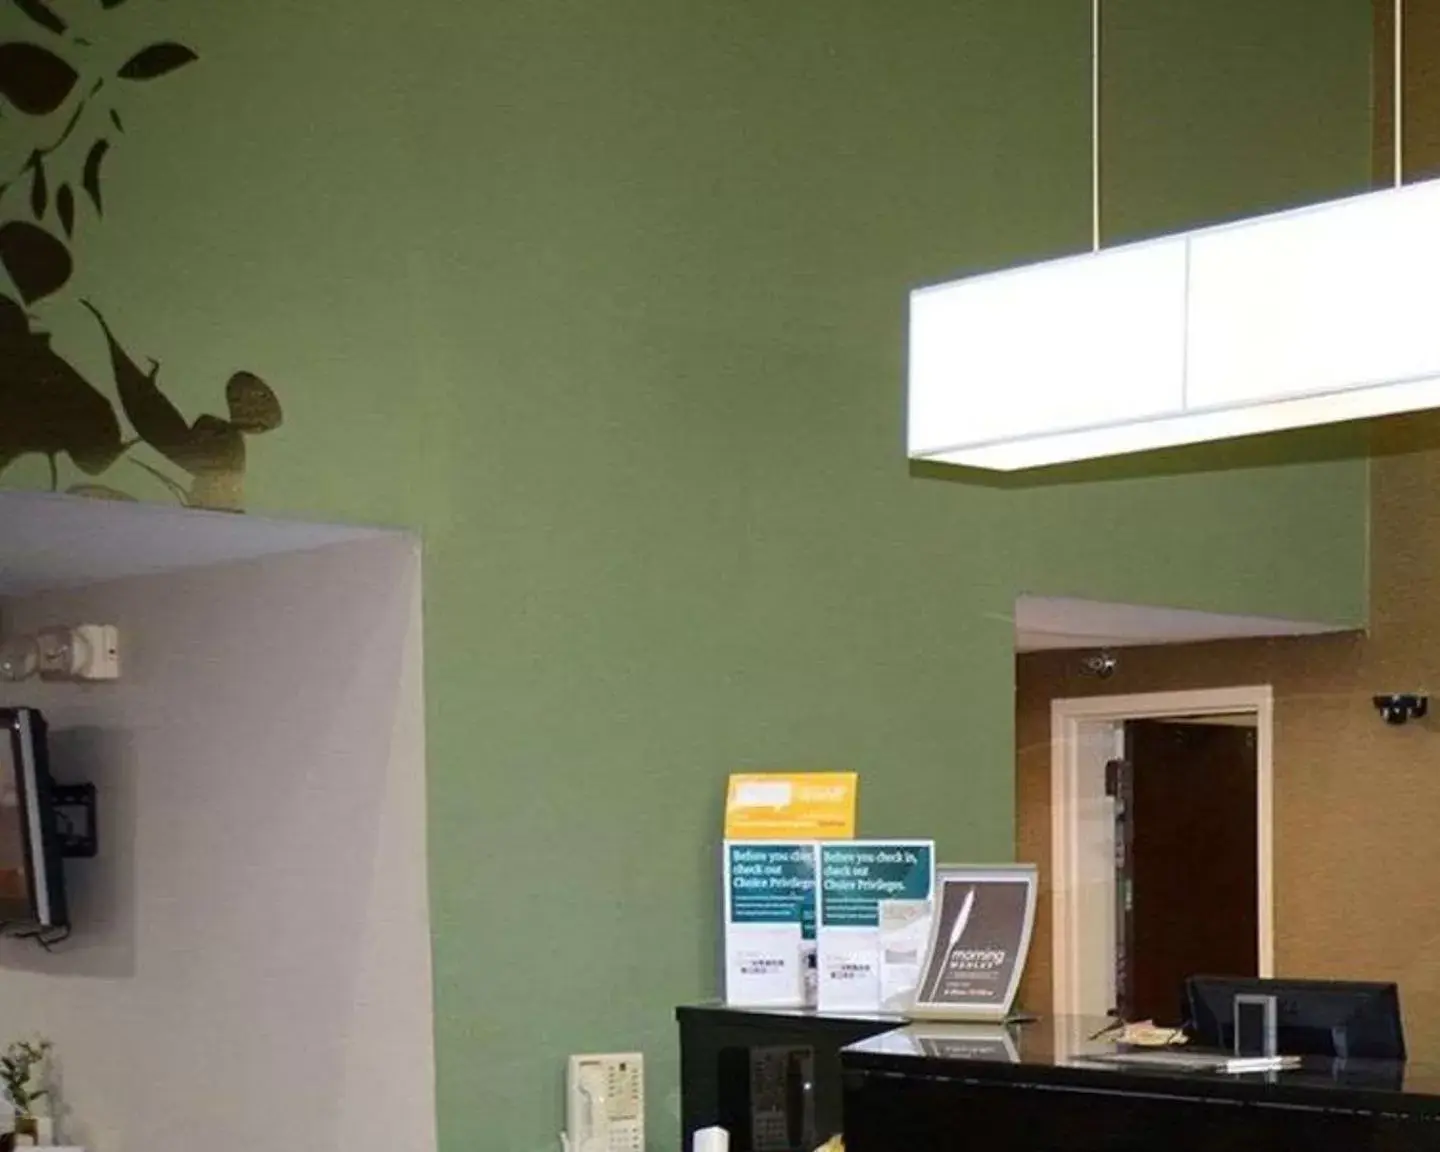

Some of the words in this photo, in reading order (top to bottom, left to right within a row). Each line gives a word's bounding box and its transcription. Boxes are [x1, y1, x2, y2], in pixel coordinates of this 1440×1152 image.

[733, 849, 767, 862] Before
[767, 851, 788, 864] you
[823, 850, 855, 863] Before
[856, 852, 874, 865] you
[875, 851, 902, 863] check
[733, 864, 762, 875] check
[763, 866, 782, 875] out
[823, 865, 851, 876] check
[852, 867, 869, 876] out
[733, 876, 768, 888] Choice
[823, 878, 856, 890] Choice
[951, 948, 1005, 966] morning
